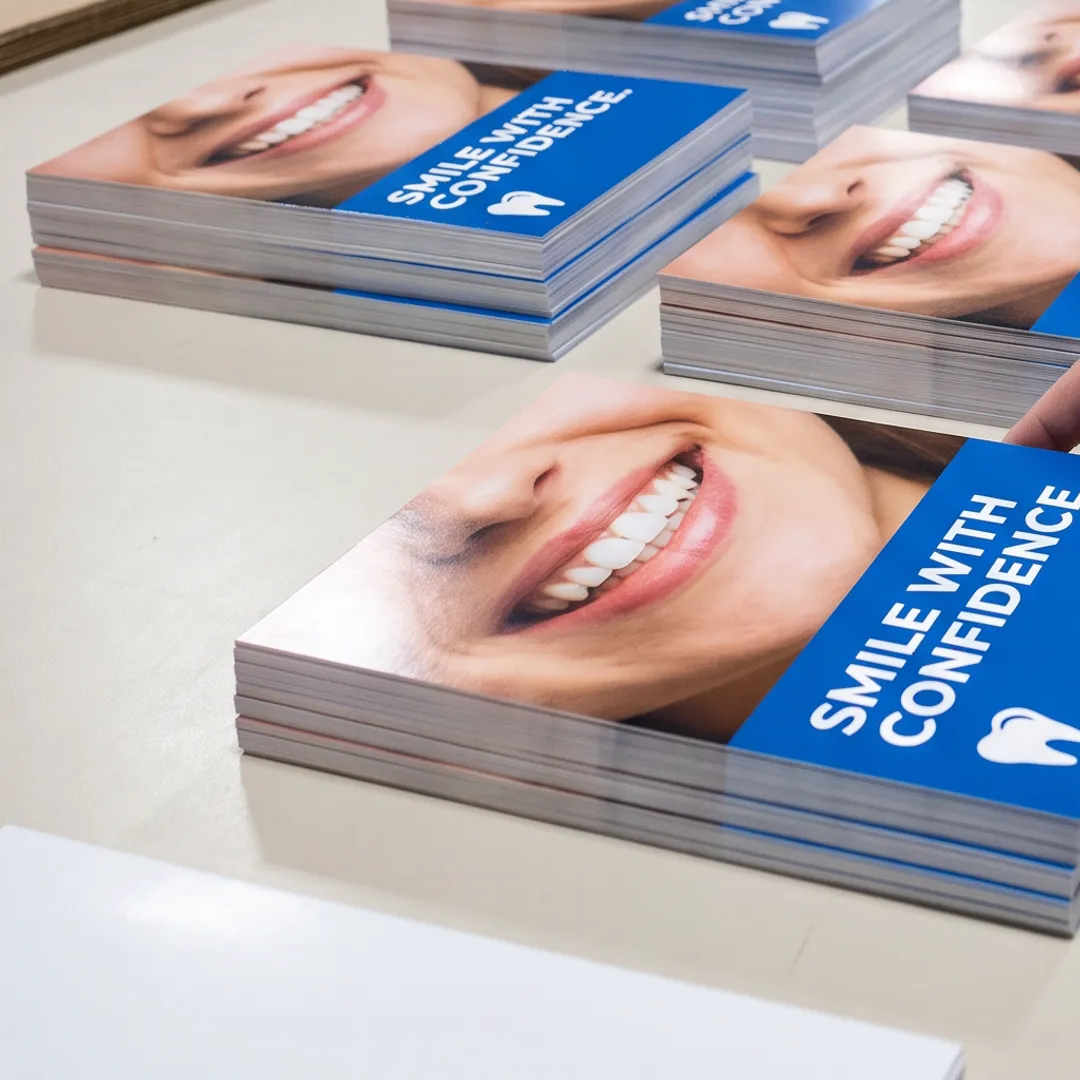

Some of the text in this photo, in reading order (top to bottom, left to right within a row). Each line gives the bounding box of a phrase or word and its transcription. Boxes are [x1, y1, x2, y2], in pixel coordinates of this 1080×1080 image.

[387, 95, 574, 206] SMILE WITH
[428, 87, 634, 211] CONFIDENCE.
[809, 494, 1018, 736] SMILE WITH
